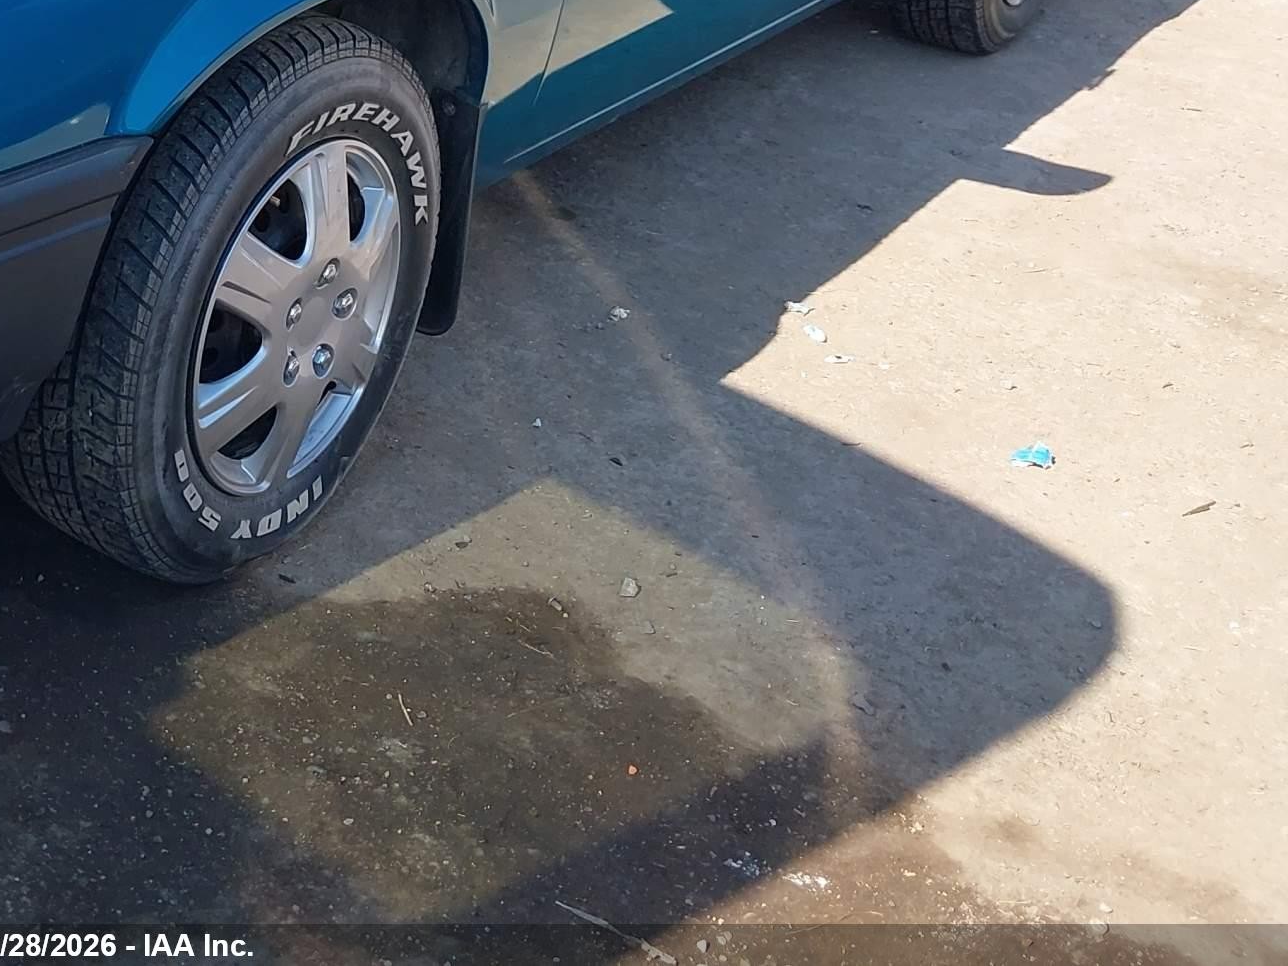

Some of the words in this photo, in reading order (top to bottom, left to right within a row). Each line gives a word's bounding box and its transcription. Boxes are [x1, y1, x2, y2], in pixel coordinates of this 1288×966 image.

[284, 101, 429, 227] FIREHAWK
[173, 448, 222, 532] 500
[230, 475, 324, 540] INDY
